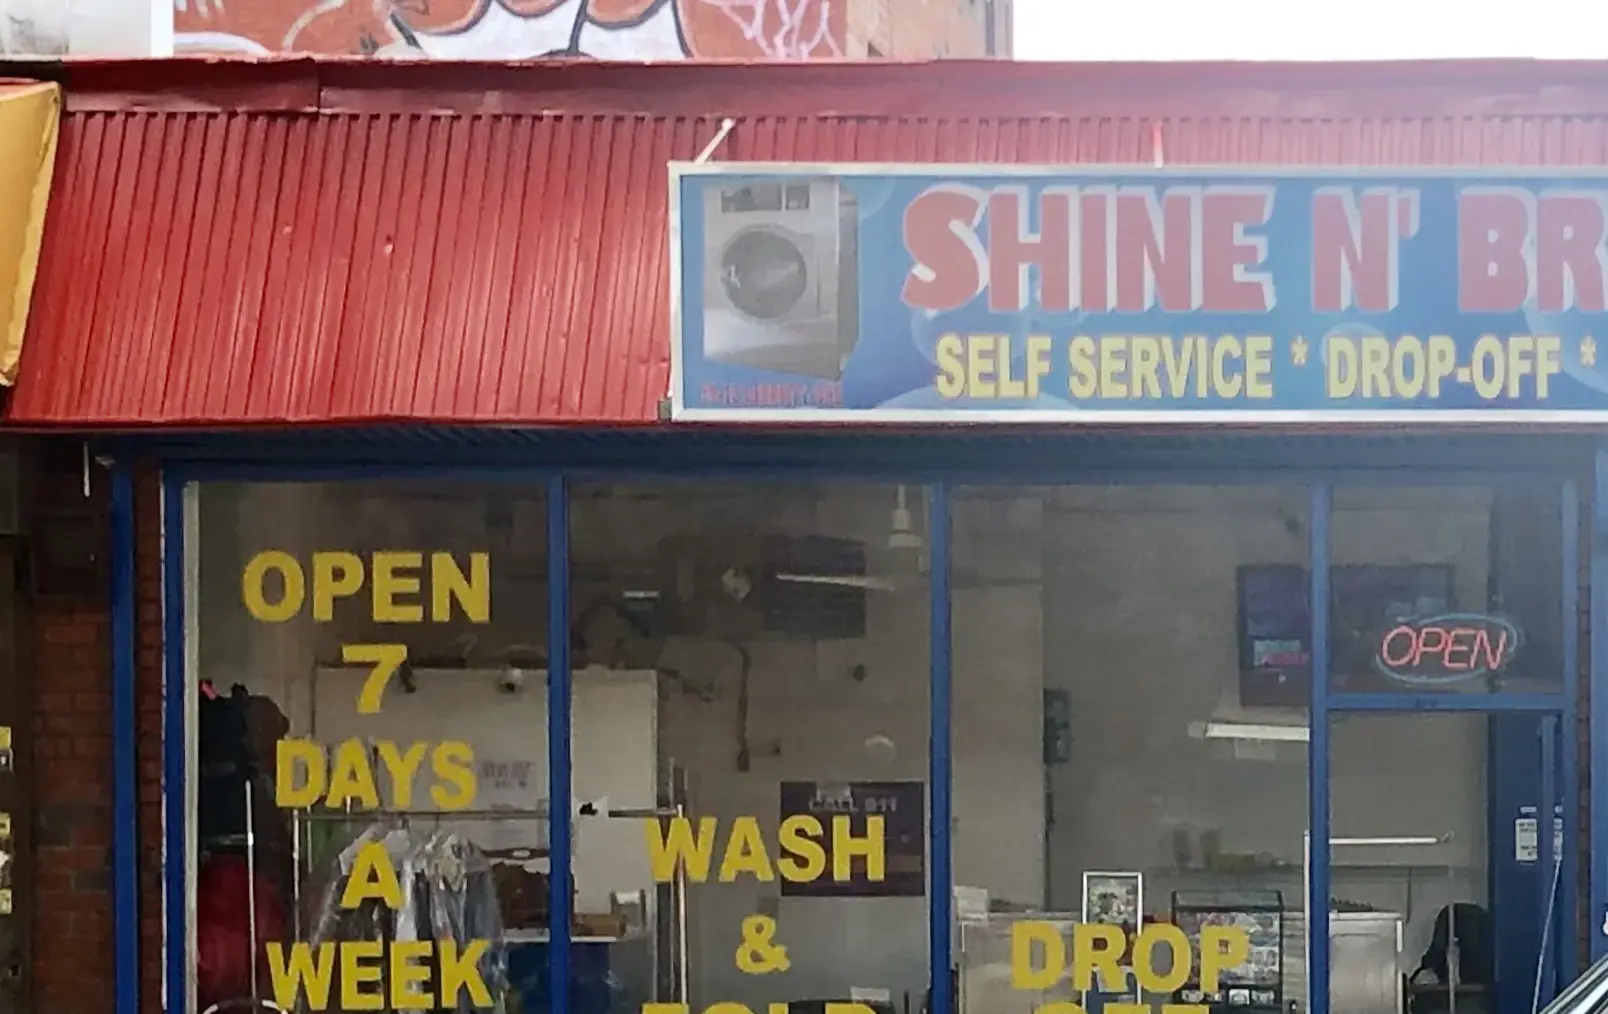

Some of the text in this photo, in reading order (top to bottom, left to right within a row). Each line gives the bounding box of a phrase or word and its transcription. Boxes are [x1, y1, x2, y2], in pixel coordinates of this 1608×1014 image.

[902, 182, 1277, 313] SHINE
[1311, 185, 1421, 313] N'
[935, 335, 1052, 399] SELF
[1067, 335, 1275, 399] SERVICE
[1327, 334, 1561, 399] DROP-OFF
[242, 549, 491, 624] OPEN
[341, 643, 408, 714] 7
[1381, 624, 1508, 671] OPEN
[275, 738, 478, 810] DAYS
[339, 839, 404, 910] A
[645, 814, 886, 883] WASH
[266, 939, 495, 1011] WEEK
[735, 913, 791, 974] &
[1011, 921, 1250, 993] DROP
